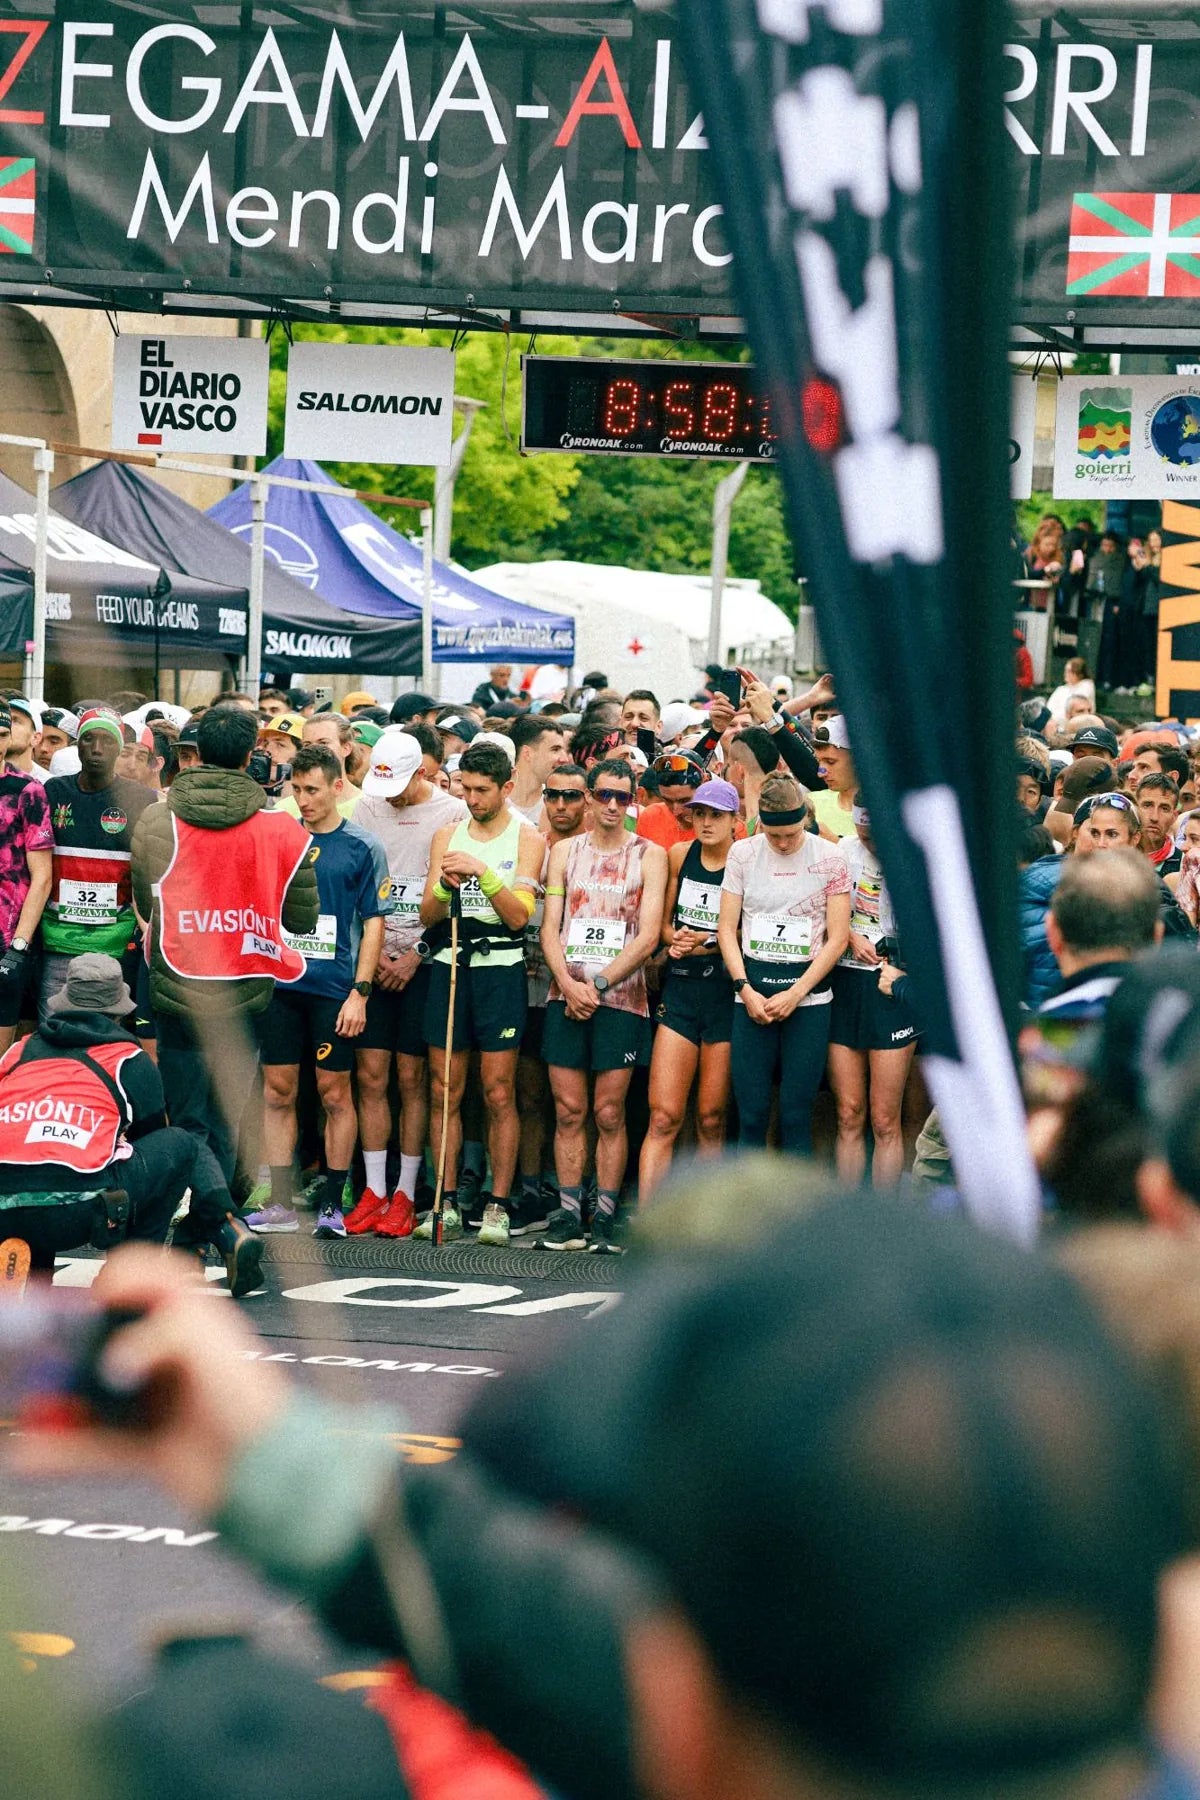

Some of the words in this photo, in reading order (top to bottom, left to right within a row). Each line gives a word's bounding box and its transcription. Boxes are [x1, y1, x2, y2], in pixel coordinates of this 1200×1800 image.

[127, 147, 439, 253] Mendi
[140, 339, 174, 367] EL
[139, 370, 241, 400] DIARIO
[297, 392, 442, 416] SALOMON
[140, 402, 237, 432] VASCO
[1075, 461, 1131, 478] goierri
[96, 595, 123, 623] FEED
[124, 598, 156, 625] YOUR
[265, 630, 352, 658] SALOMON
[391, 885, 407, 897] 27
[463, 880, 480, 891] 29
[78, 891, 97, 903] 32
[700, 893, 709, 905] 1
[65, 907, 110, 917] ZEGAMA
[396, 903, 419, 913] AMA
[585, 928, 605, 940] 28
[776, 925, 786, 937] 7
[253, 938, 276, 955] PLAY
[571, 945, 617, 957] ZEGAMA
[756, 941, 803, 954] ZEGAMA
[891, 1026, 914, 1041] HOKA
[42, 1126, 79, 1141] PLAY
